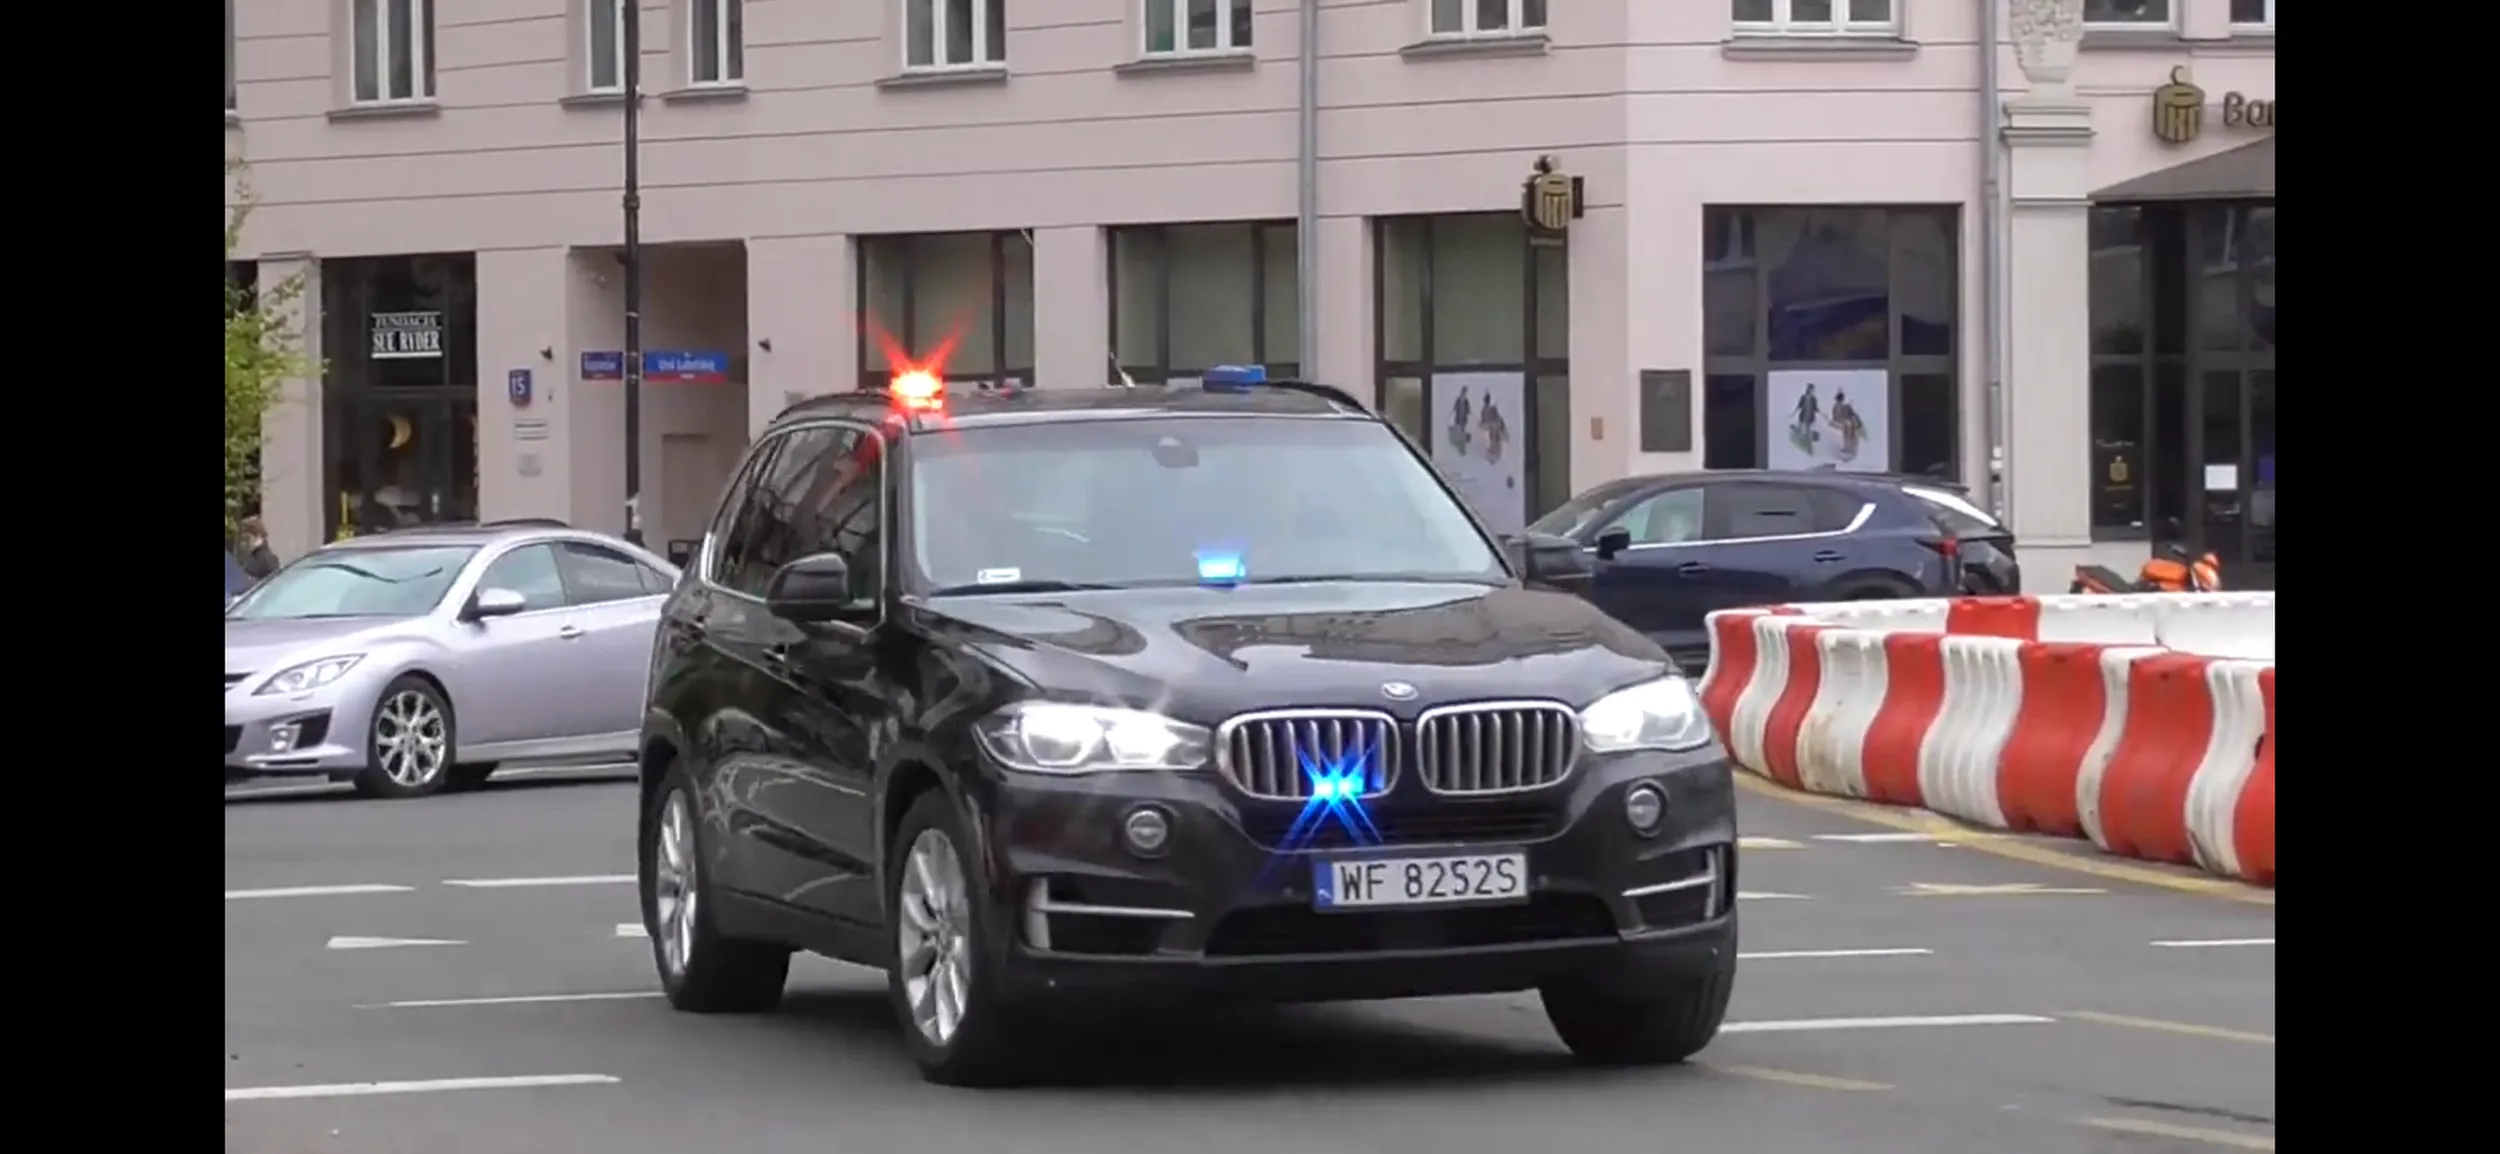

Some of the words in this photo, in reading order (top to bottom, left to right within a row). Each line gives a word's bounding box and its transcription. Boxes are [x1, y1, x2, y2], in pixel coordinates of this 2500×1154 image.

[400, 331, 440, 351] RYDER
[511, 376, 526, 395] 15
[1340, 862, 1387, 901] WF
[1404, 857, 1517, 899] 8252S
